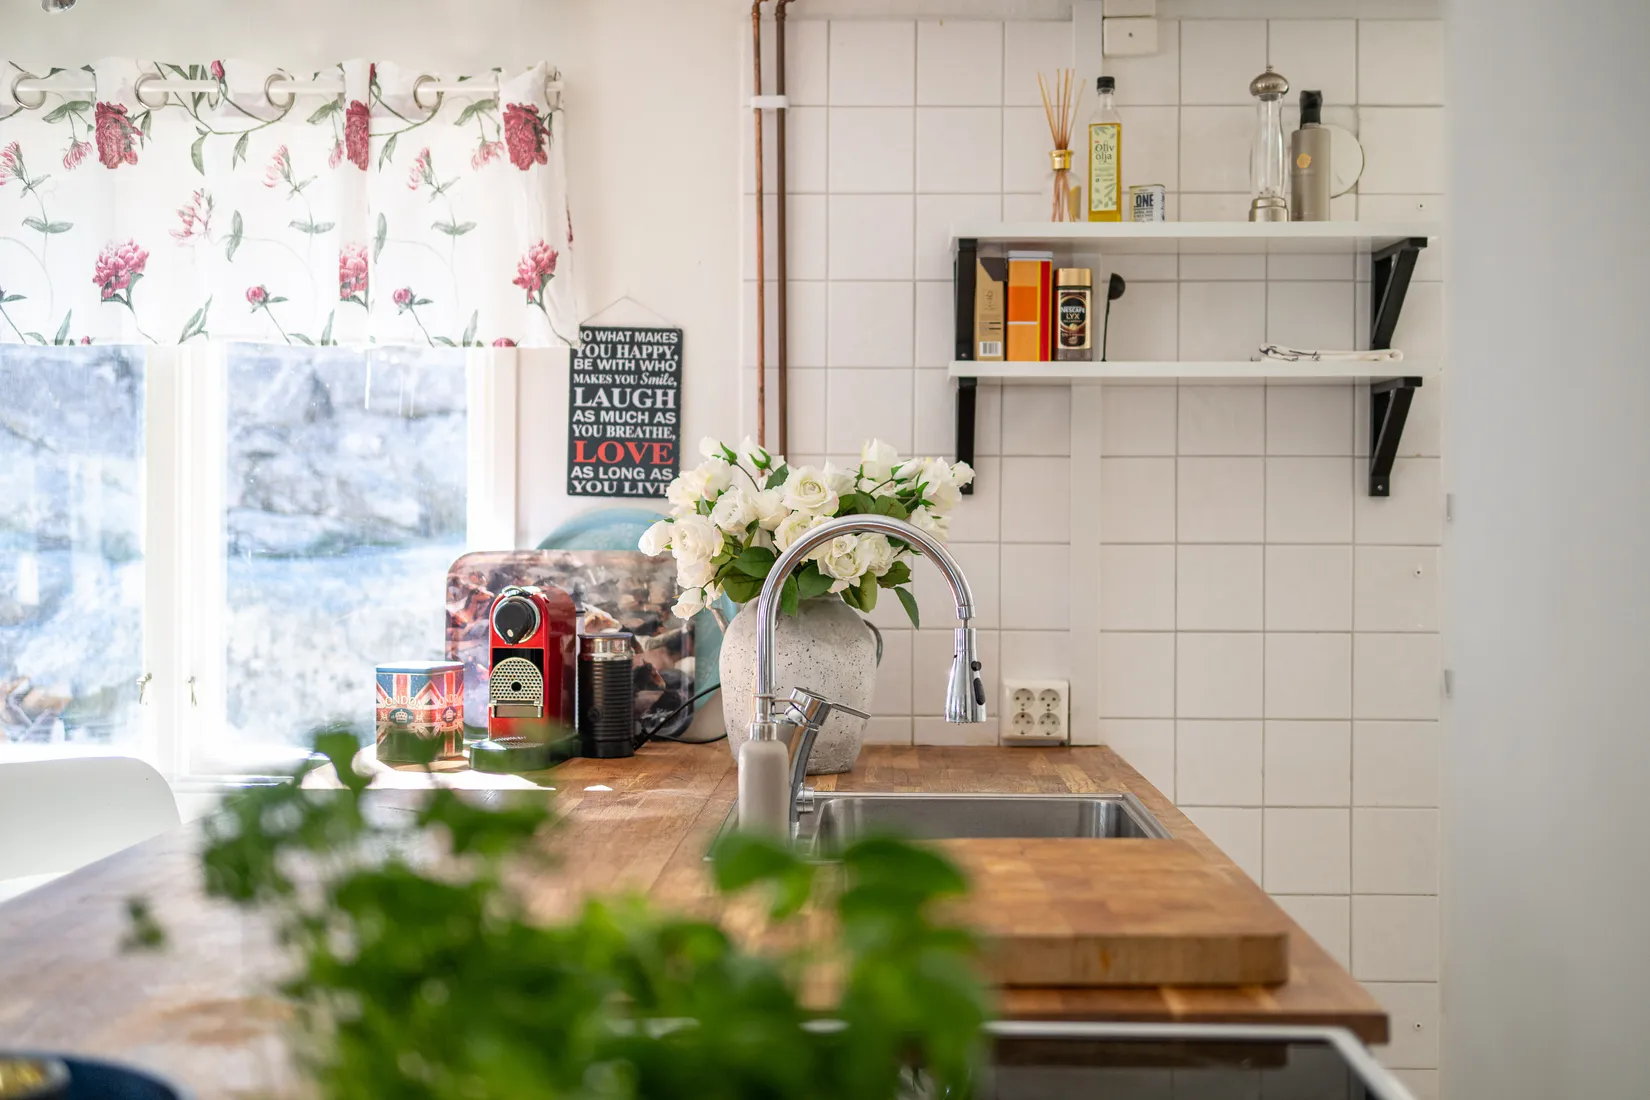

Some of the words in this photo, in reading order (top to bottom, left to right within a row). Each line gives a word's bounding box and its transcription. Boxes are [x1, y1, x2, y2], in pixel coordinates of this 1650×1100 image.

[1095, 151, 1112, 163] olja
[1136, 194, 1154, 207] ONE
[580, 330, 592, 341] O
[595, 331, 632, 342] WHAT
[634, 332, 678, 343] MAKES
[576, 343, 612, 358] YOU
[616, 344, 679, 361] HAPPY,
[574, 358, 593, 370] BE
[597, 359, 636, 371] WITH
[639, 360, 676, 372] WHO
[573, 373, 612, 384] MAKES
[614, 374, 638, 385] YOU
[640, 371, 677, 387] Smile,
[573, 386, 677, 409] LAUGH
[573, 410, 596, 423] AS
[600, 411, 649, 424] MUCH
[653, 411, 677, 425] AS
[572, 424, 602, 437] YOU
[606, 425, 677, 441] BREATHE,
[573, 440, 674, 465] LOVE
[571, 465, 594, 479] AS
[599, 466, 645, 480] LONG
[650, 468, 674, 481] AS
[572, 480, 617, 493] YOU
